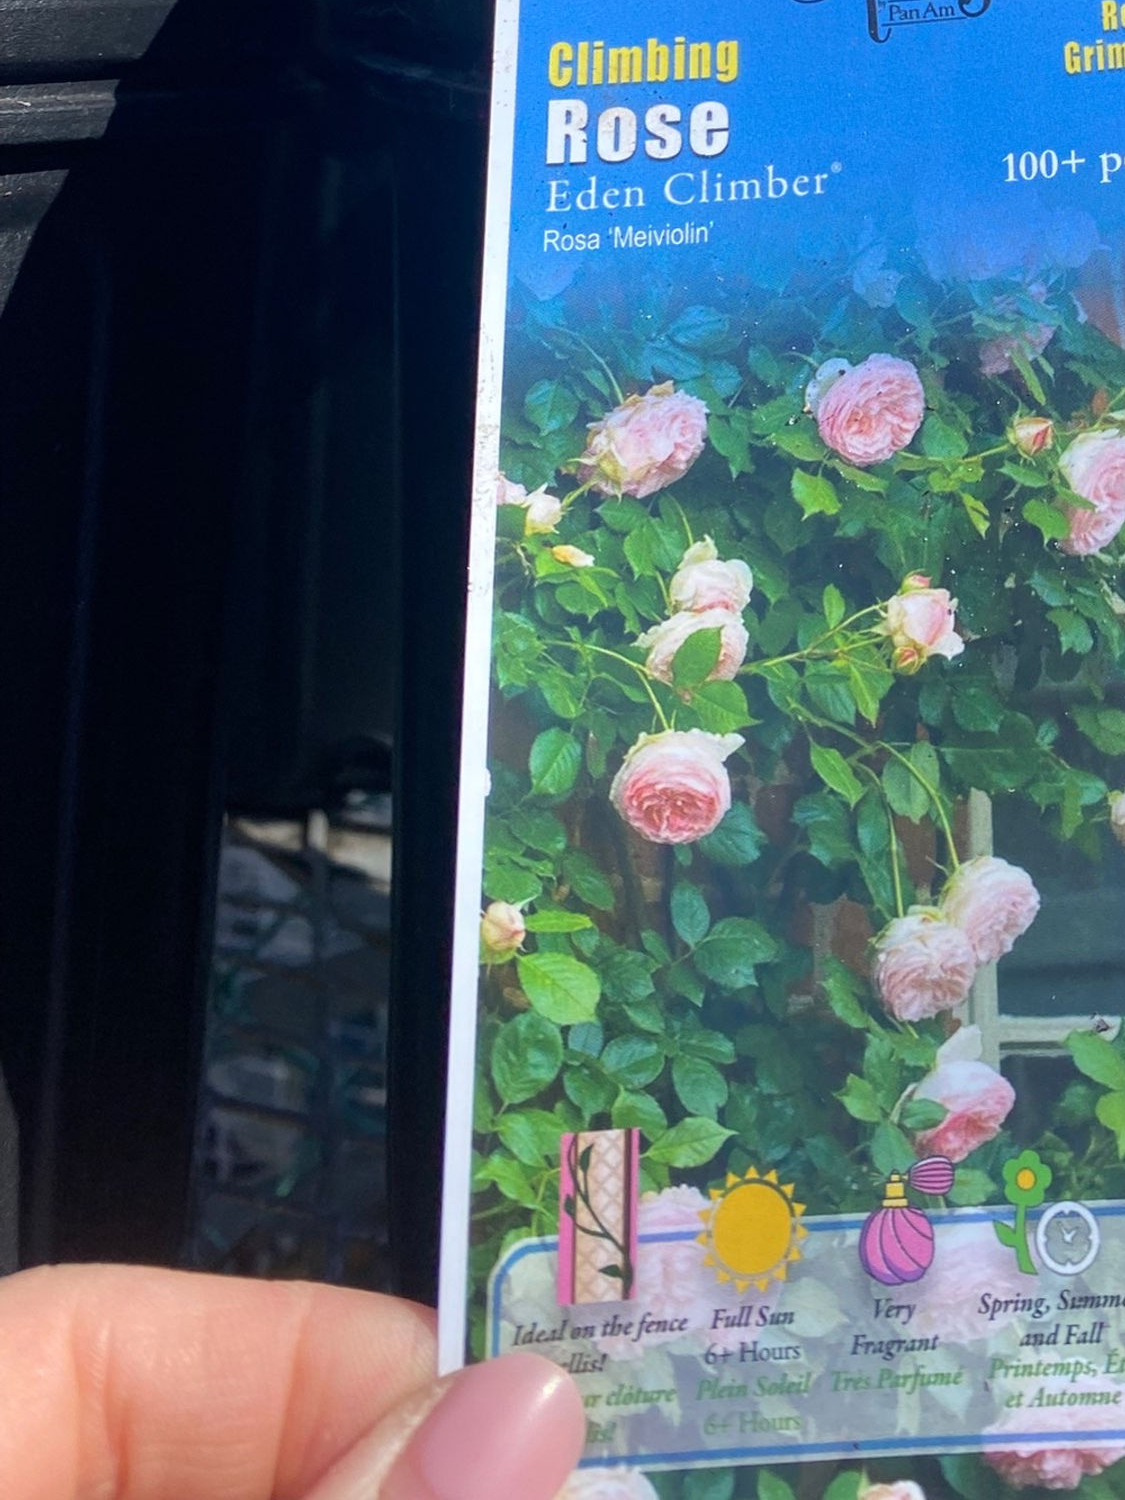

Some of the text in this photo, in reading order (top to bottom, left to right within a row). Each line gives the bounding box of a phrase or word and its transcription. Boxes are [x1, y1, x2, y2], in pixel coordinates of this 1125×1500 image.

[888, 4, 920, 22] Pan
[922, 1, 956, 19] Am
[548, 37, 739, 88] Climbing
[546, 98, 731, 165] Rose
[1002, 149, 1086, 182] 100+
[545, 175, 645, 212] Eden
[543, 229, 601, 252] Rosa
[710, 1304, 795, 1329] Full Sun
[872, 1298, 917, 1325] Very
[977, 1292, 1050, 1320] Spring,
[512, 1311, 688, 1346] Ideal on the fence
[1018, 1321, 1107, 1348] and Fall
[704, 1339, 801, 1365] 6+ Hours
[851, 1333, 940, 1362] Fragrant
[561, 1352, 609, 1375] llis!
[988, 1355, 1098, 1383] Printemps,
[697, 1377, 748, 1400] Plein
[1004, 1387, 1123, 1409] et Automne
[703, 1410, 802, 1436] 6+ Hours
